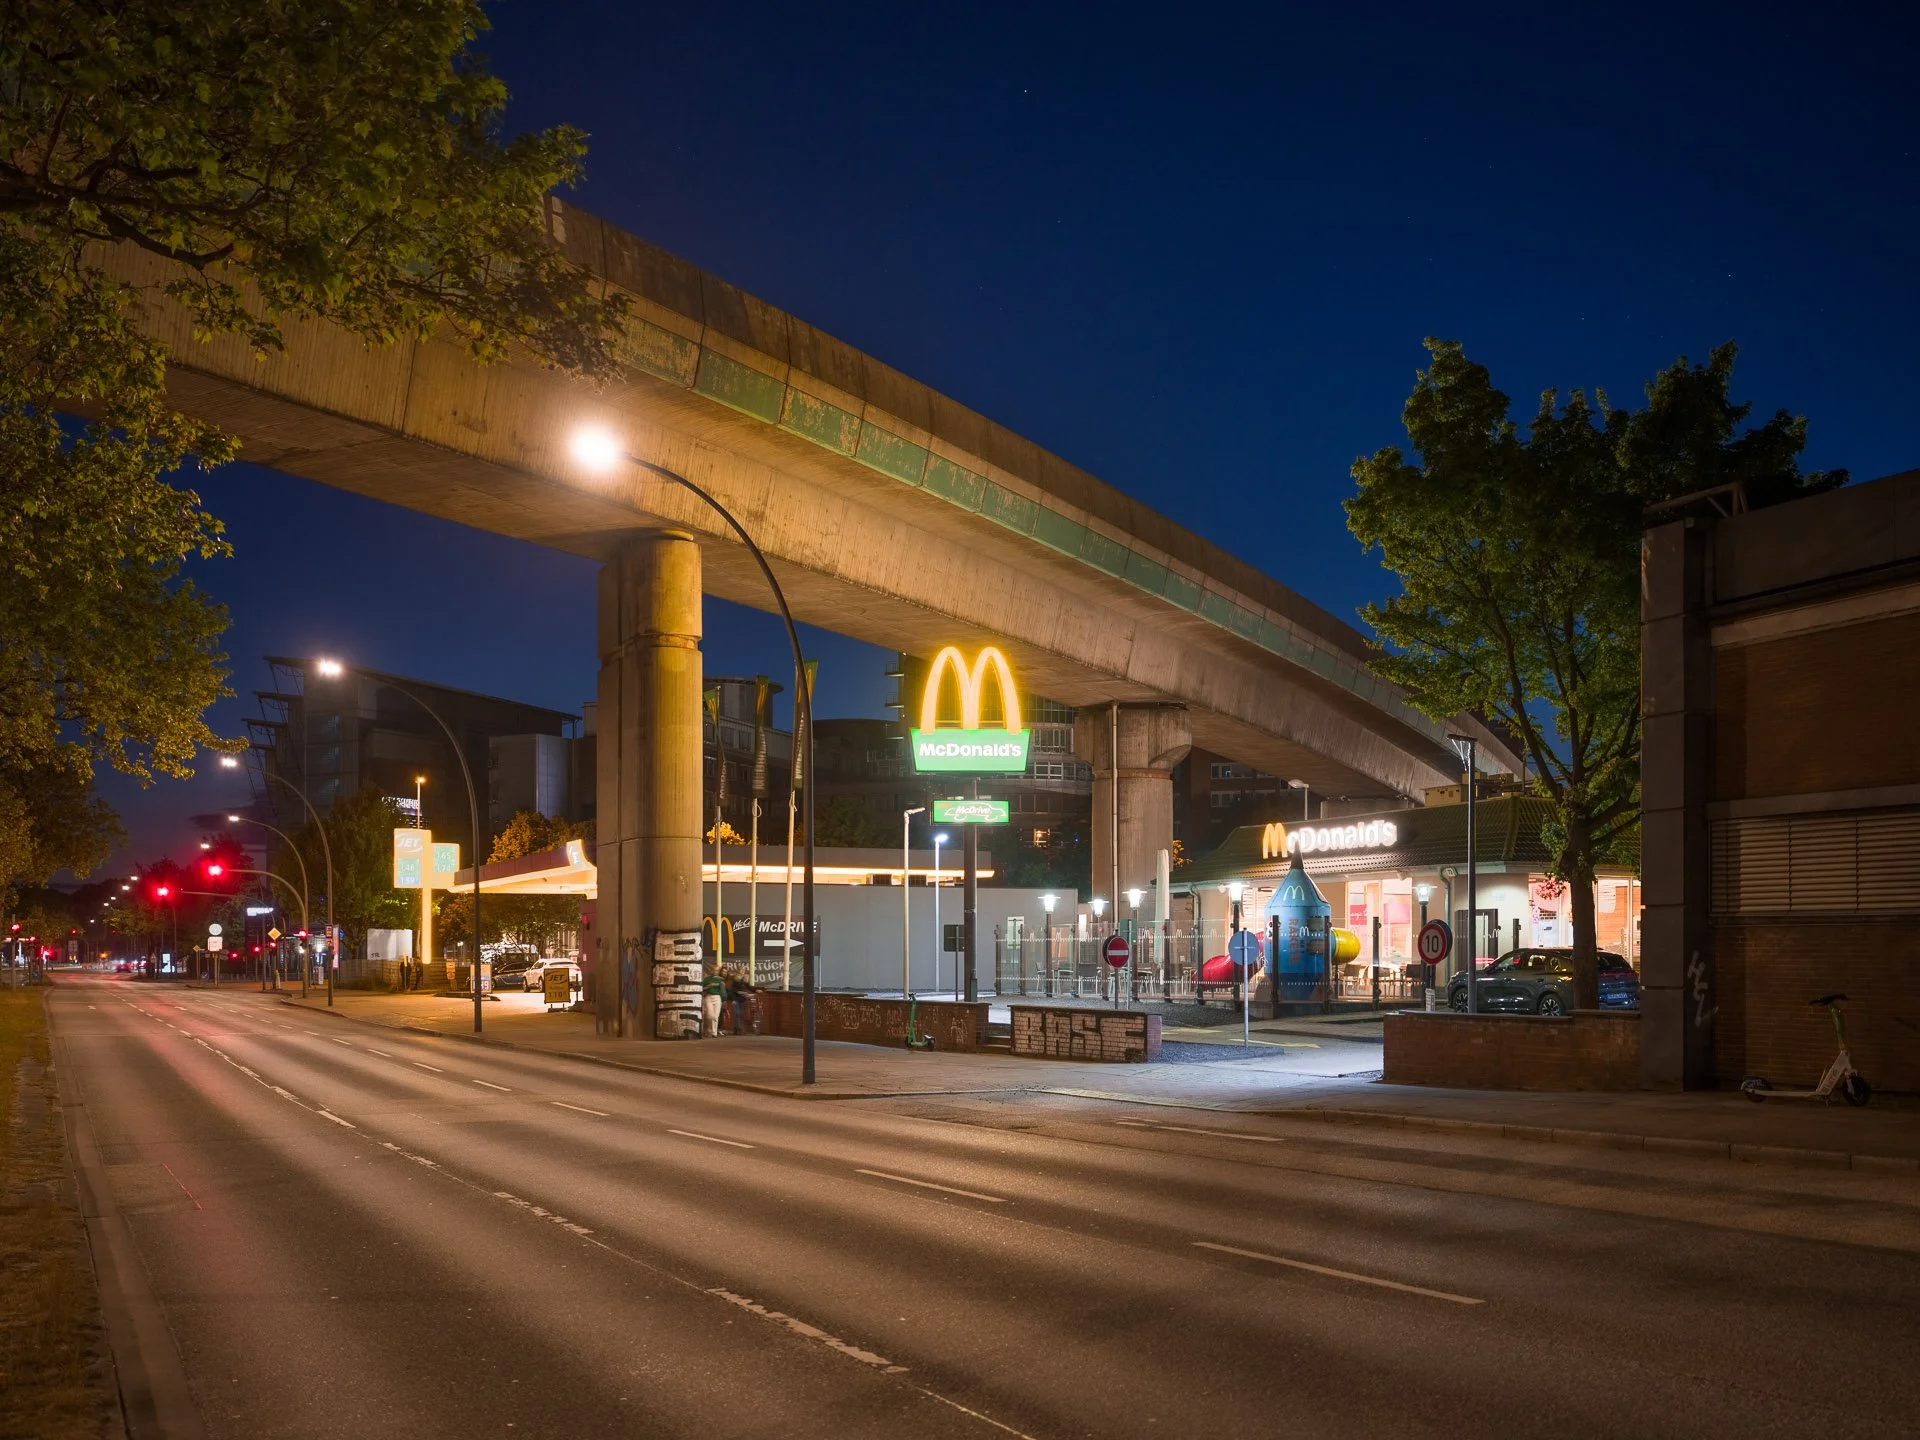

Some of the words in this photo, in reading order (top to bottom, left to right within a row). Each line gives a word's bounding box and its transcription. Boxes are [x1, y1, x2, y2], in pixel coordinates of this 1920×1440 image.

[919, 743, 1021, 757] McDonald's
[955, 806, 992, 815] McDrive
[398, 837, 421, 848] JET
[1262, 820, 1397, 859] McDonald's
[1425, 935, 1439, 953] 10
[548, 974, 565, 982] JET
